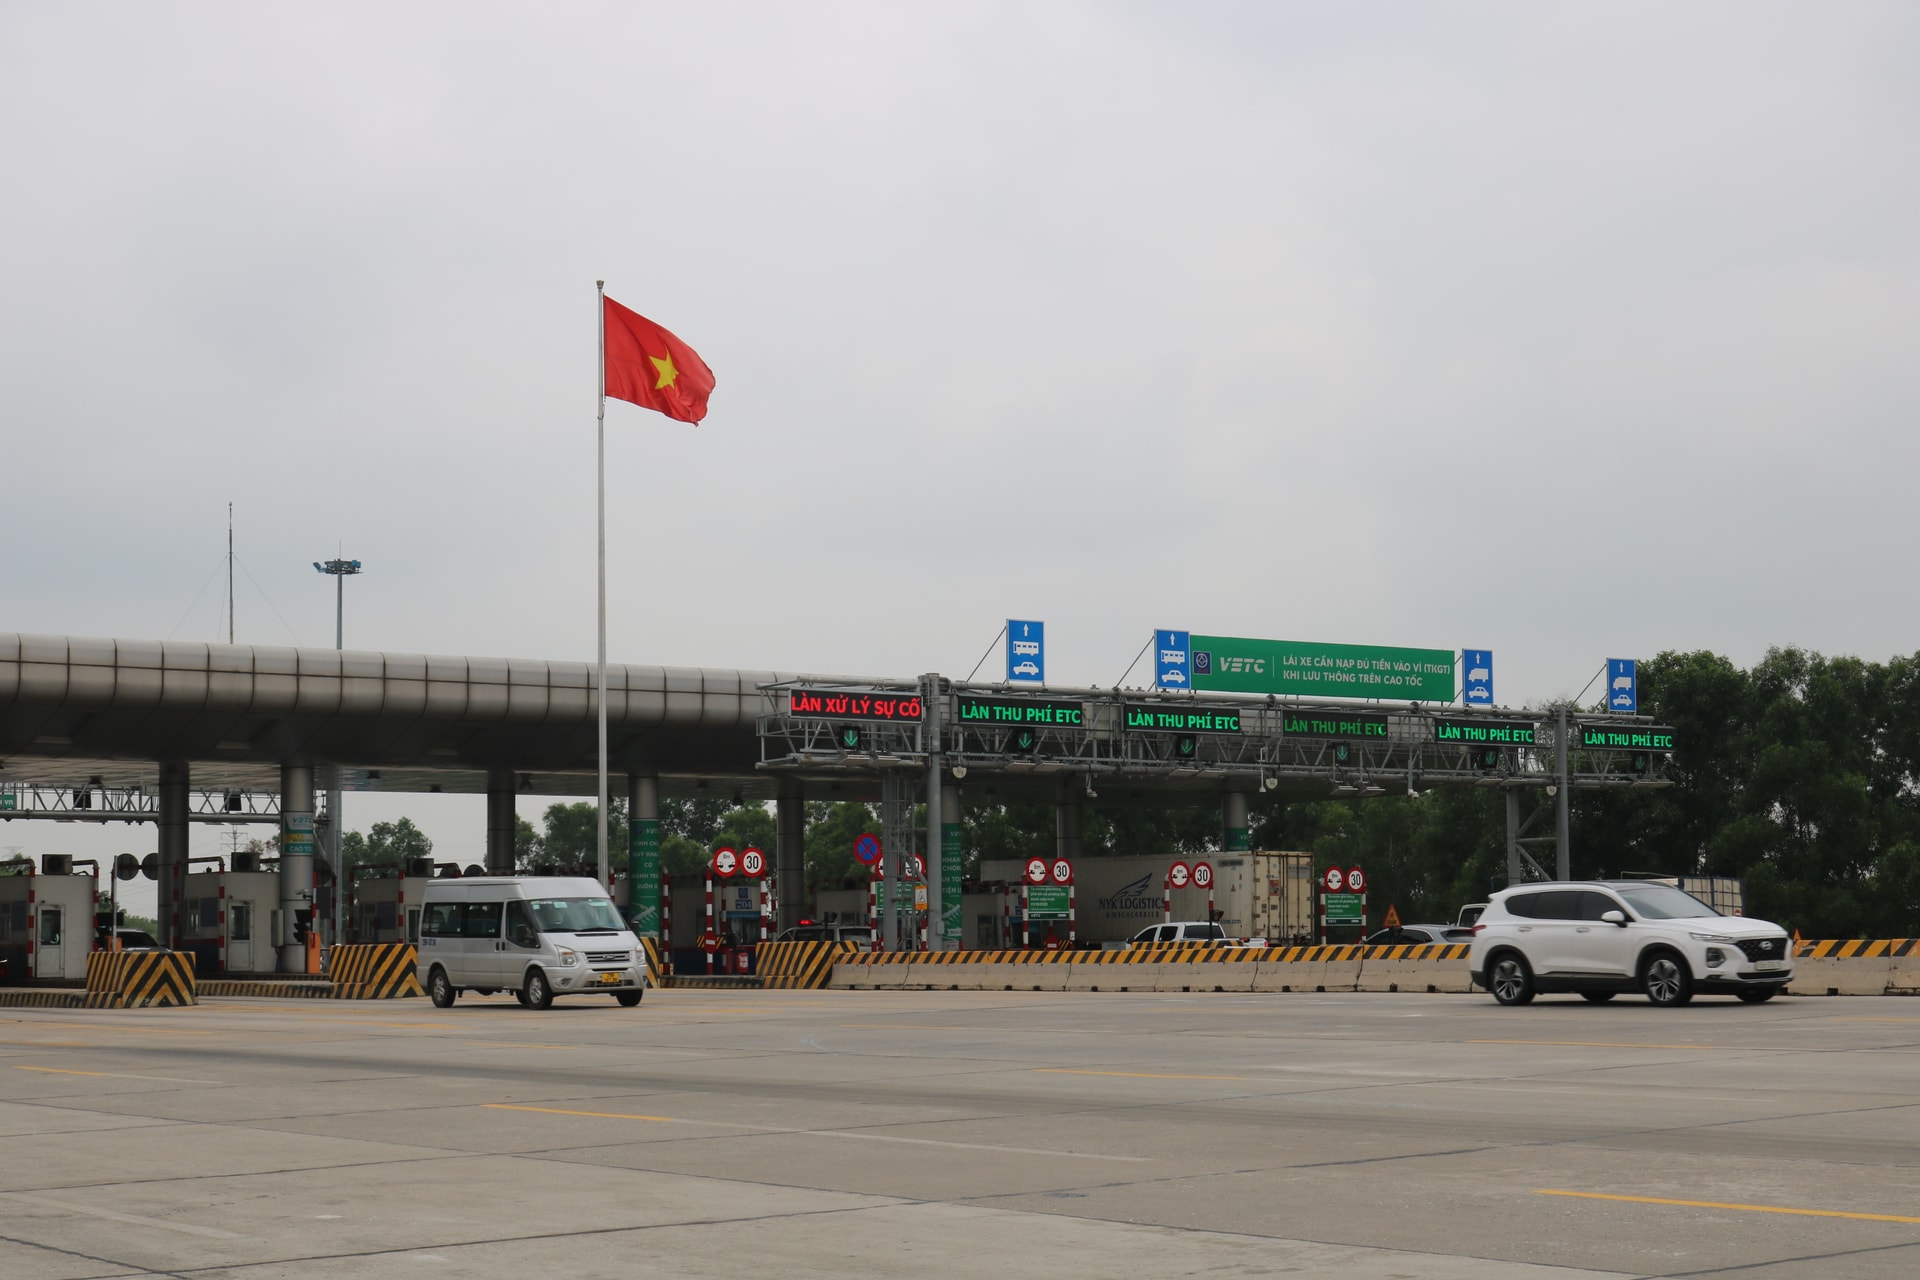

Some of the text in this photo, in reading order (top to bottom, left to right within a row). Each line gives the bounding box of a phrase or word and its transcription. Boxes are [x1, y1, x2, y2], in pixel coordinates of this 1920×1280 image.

[1220, 657, 1265, 673] VETC
[1300, 657, 1312, 666] XE
[1336, 658, 1354, 670] NẠP
[1393, 660, 1410, 672] VÀO
[1424, 664, 1450, 674] (TKGT)
[1283, 670, 1422, 686] KHI LƯU THÔNG TRÊN CAO TỐC
[791, 692, 821, 712] LÀN
[826, 694, 848, 714] XỬ
[852, 695, 870, 714] LÝ
[874, 700, 896, 718] SỰ
[962, 700, 1080, 724] LÀN THU PHÍ ETC
[1128, 708, 1238, 730] LÀN THU PHÍ ETC
[1284, 715, 1386, 736] LÀN THU PHÍ ETC
[1439, 722, 1533, 742] LÀN THU PHÍ ETC
[1585, 728, 1672, 748] LÀN THU PHÍ ETC
[746, 856, 759, 870] 30
[1056, 865, 1068, 878] 30
[1197, 869, 1208, 882] 30
[1350, 874, 1360, 886] 30
[1098, 898, 1117, 910] NYK
